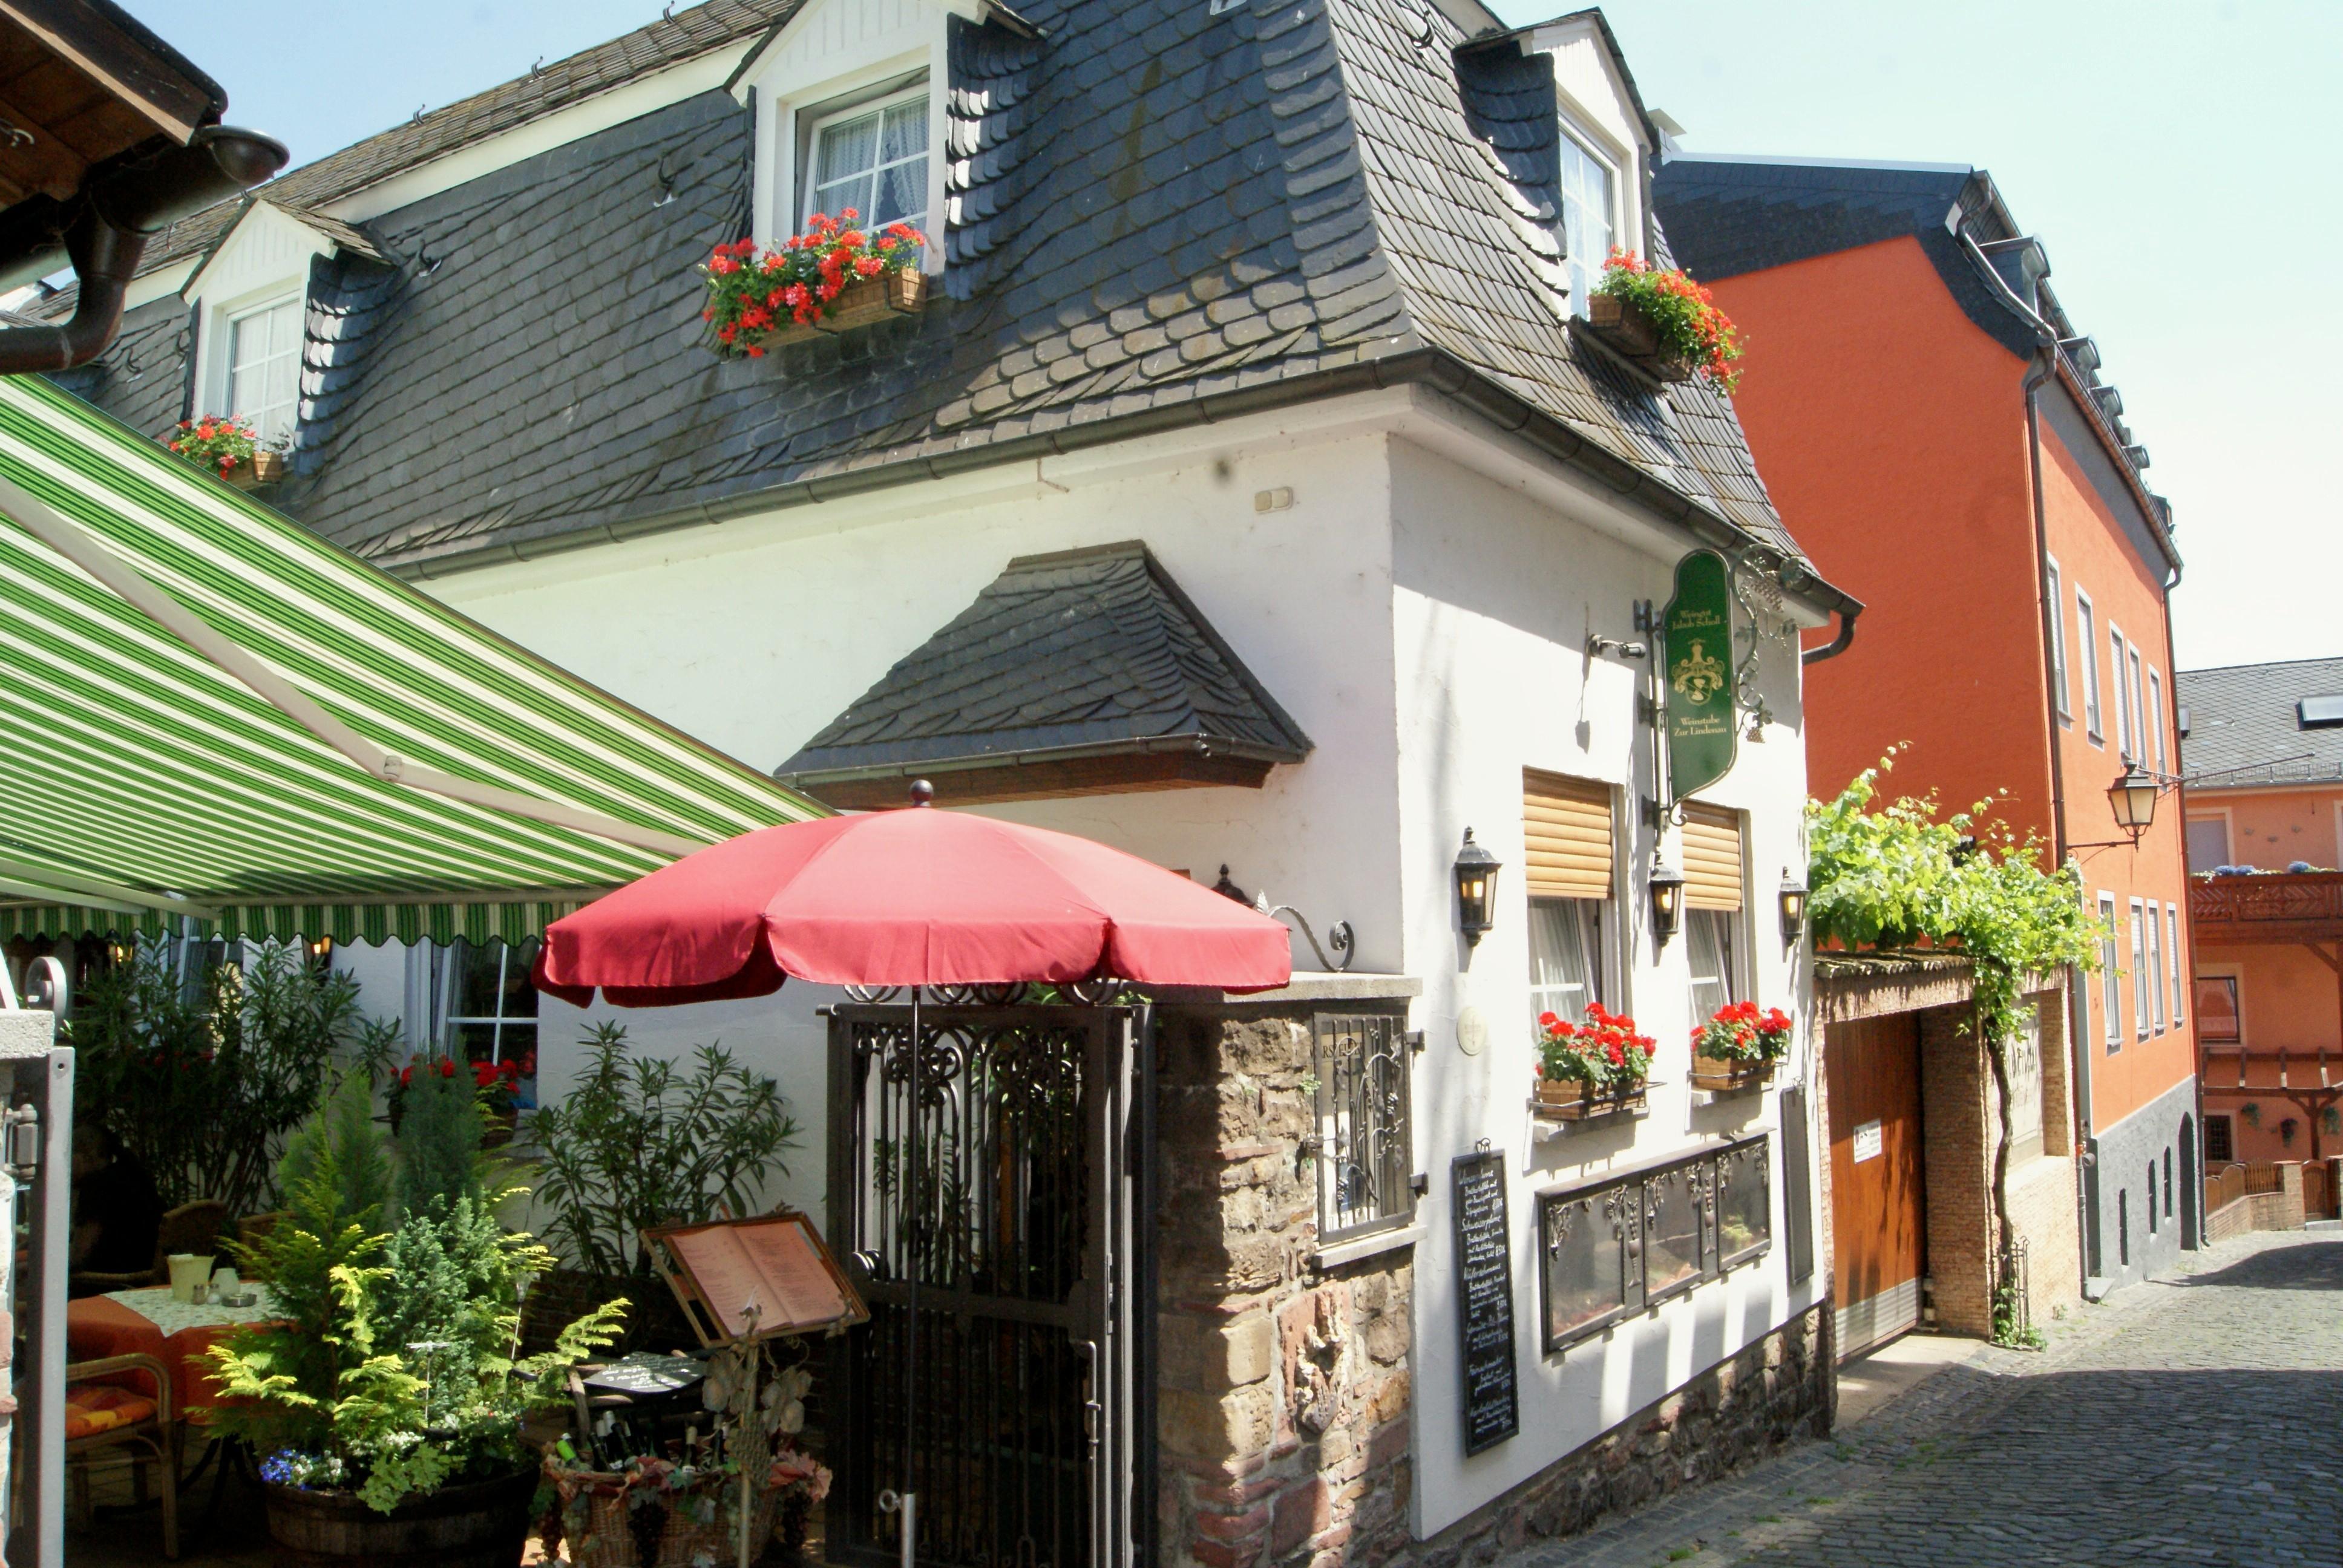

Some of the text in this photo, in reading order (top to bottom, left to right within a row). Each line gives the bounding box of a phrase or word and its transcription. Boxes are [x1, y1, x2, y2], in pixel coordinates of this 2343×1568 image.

[1680, 714, 1720, 725] Weinstube
[1674, 725, 1727, 736] Zur Lindenau
